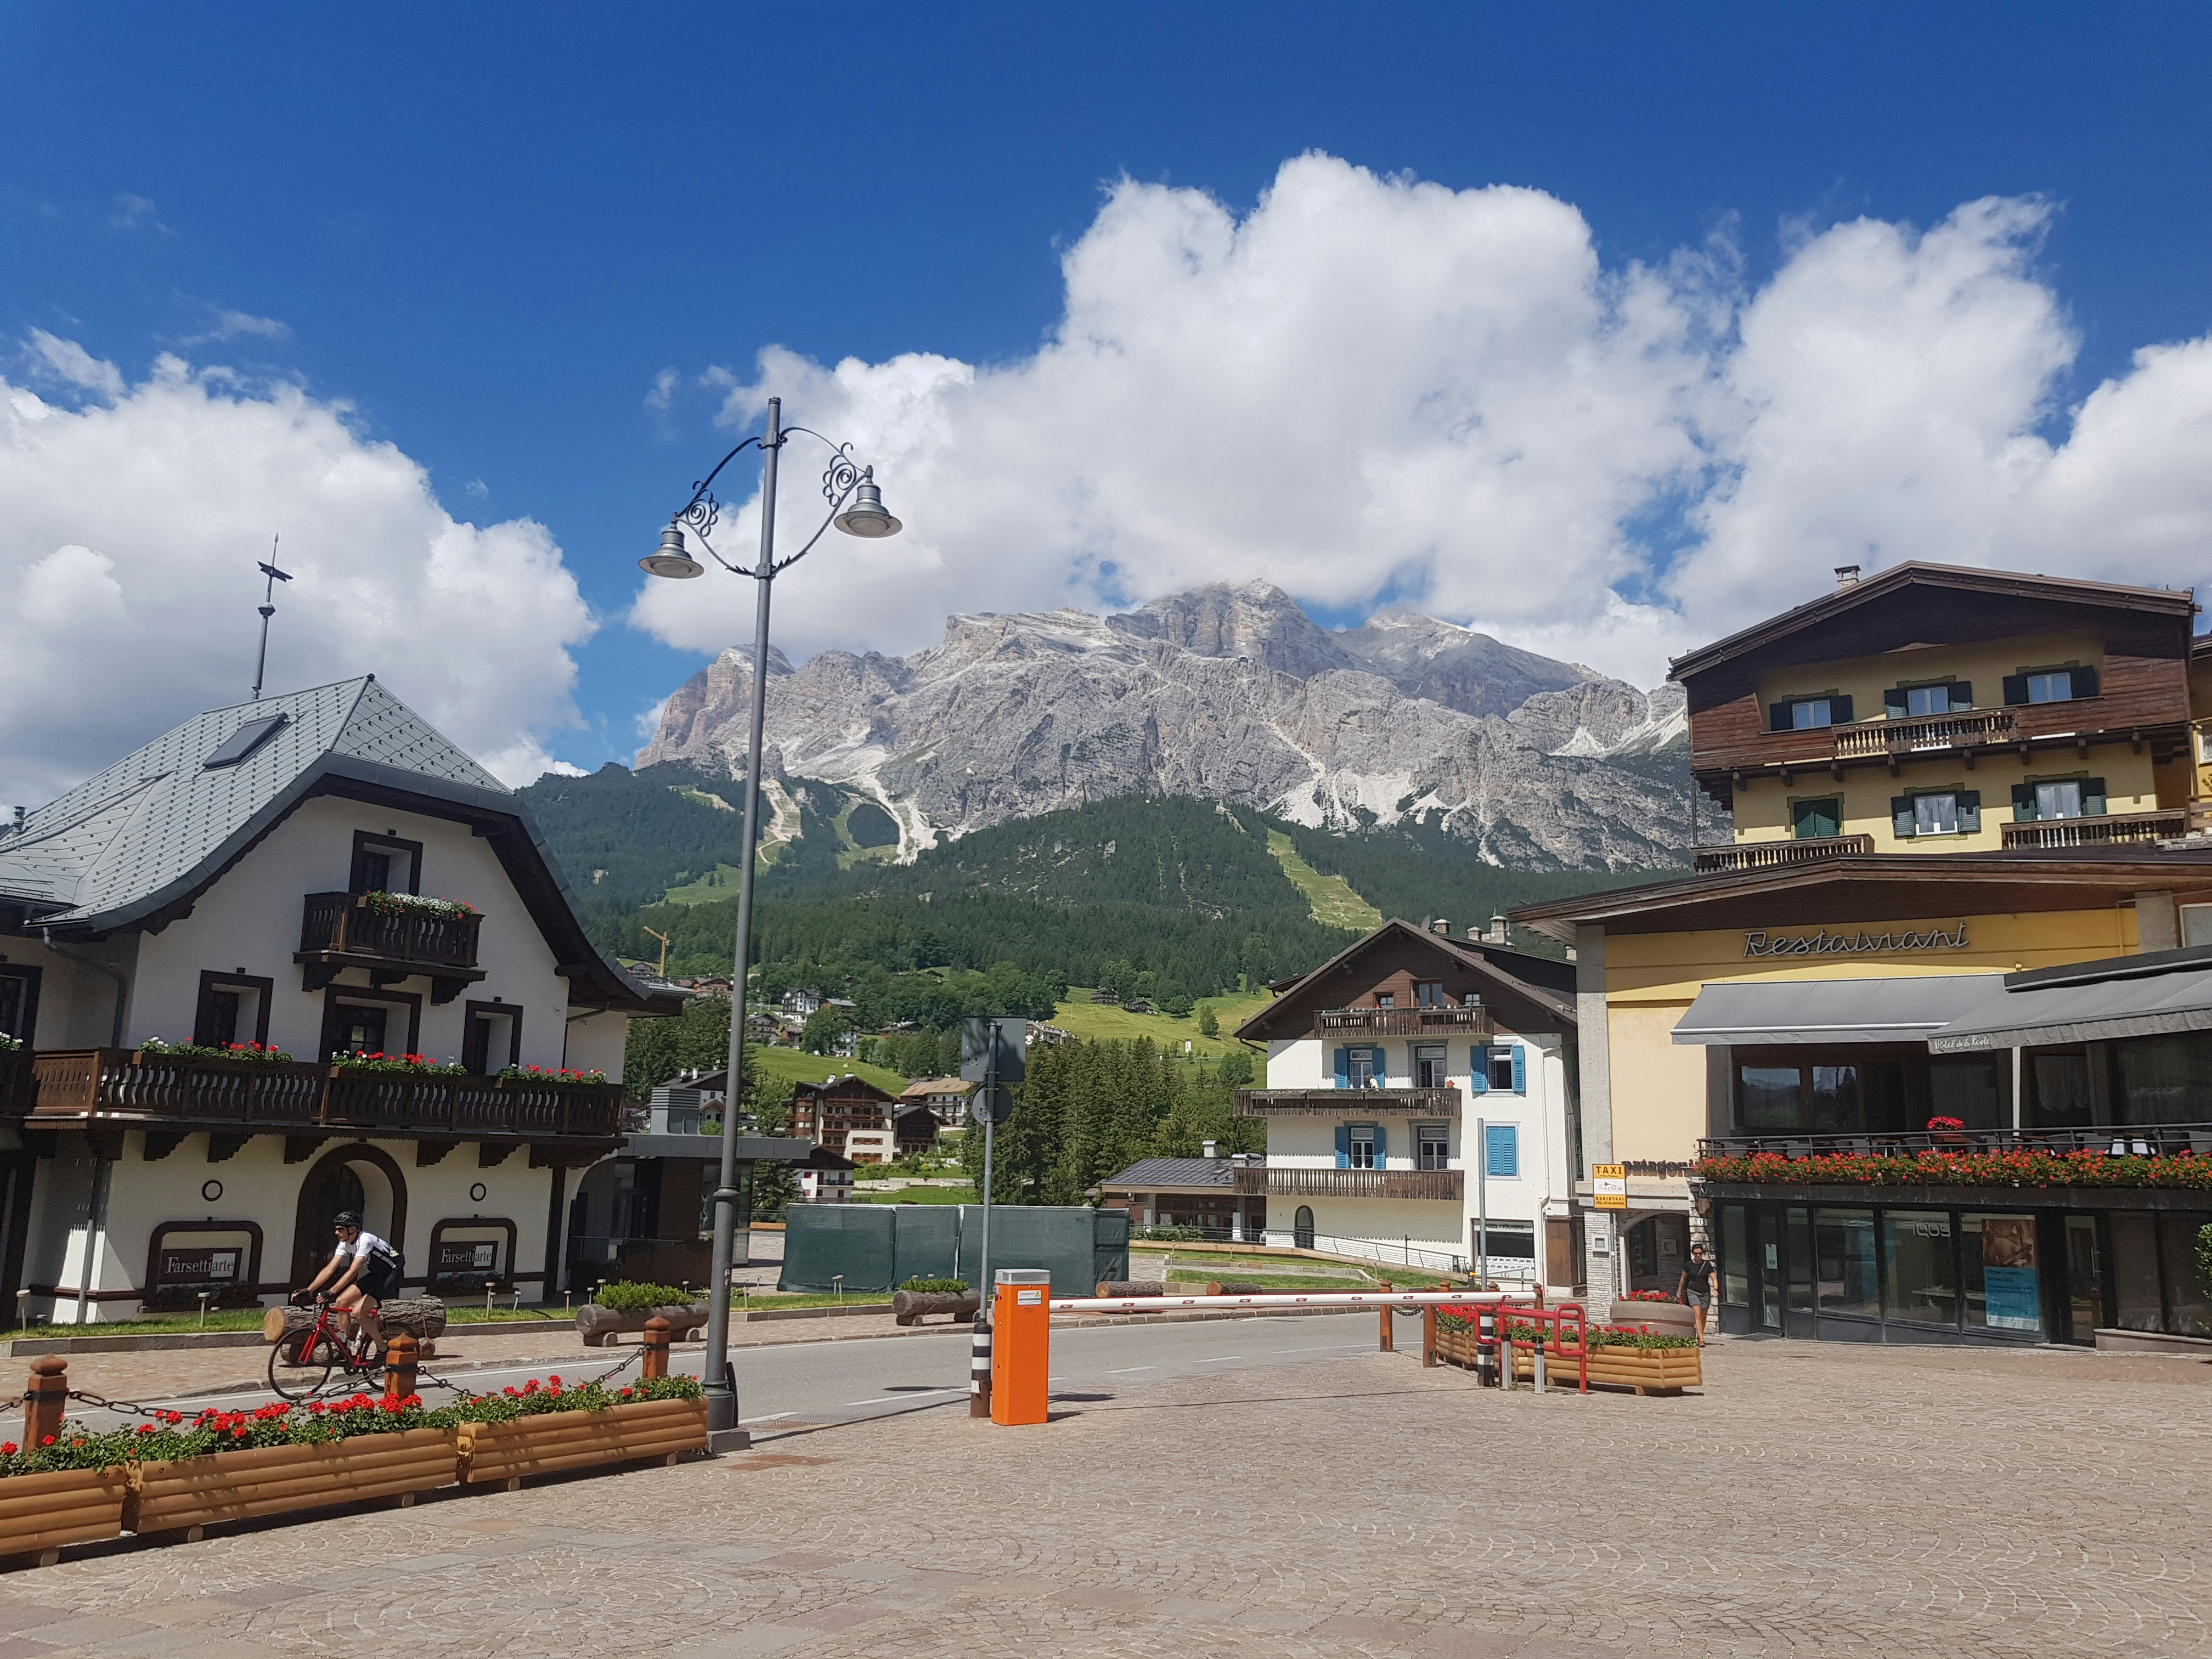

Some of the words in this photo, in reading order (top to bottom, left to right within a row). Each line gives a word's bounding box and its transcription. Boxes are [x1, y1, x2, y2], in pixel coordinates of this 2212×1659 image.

[1743, 918, 1970, 957] Restaurant
[1595, 1166, 1622, 1175] TAXI
[1621, 1159, 1700, 1175] patagoni
[441, 1248, 492, 1263] Farsettiarte
[166, 1256, 234, 1273] Farsettiarte
